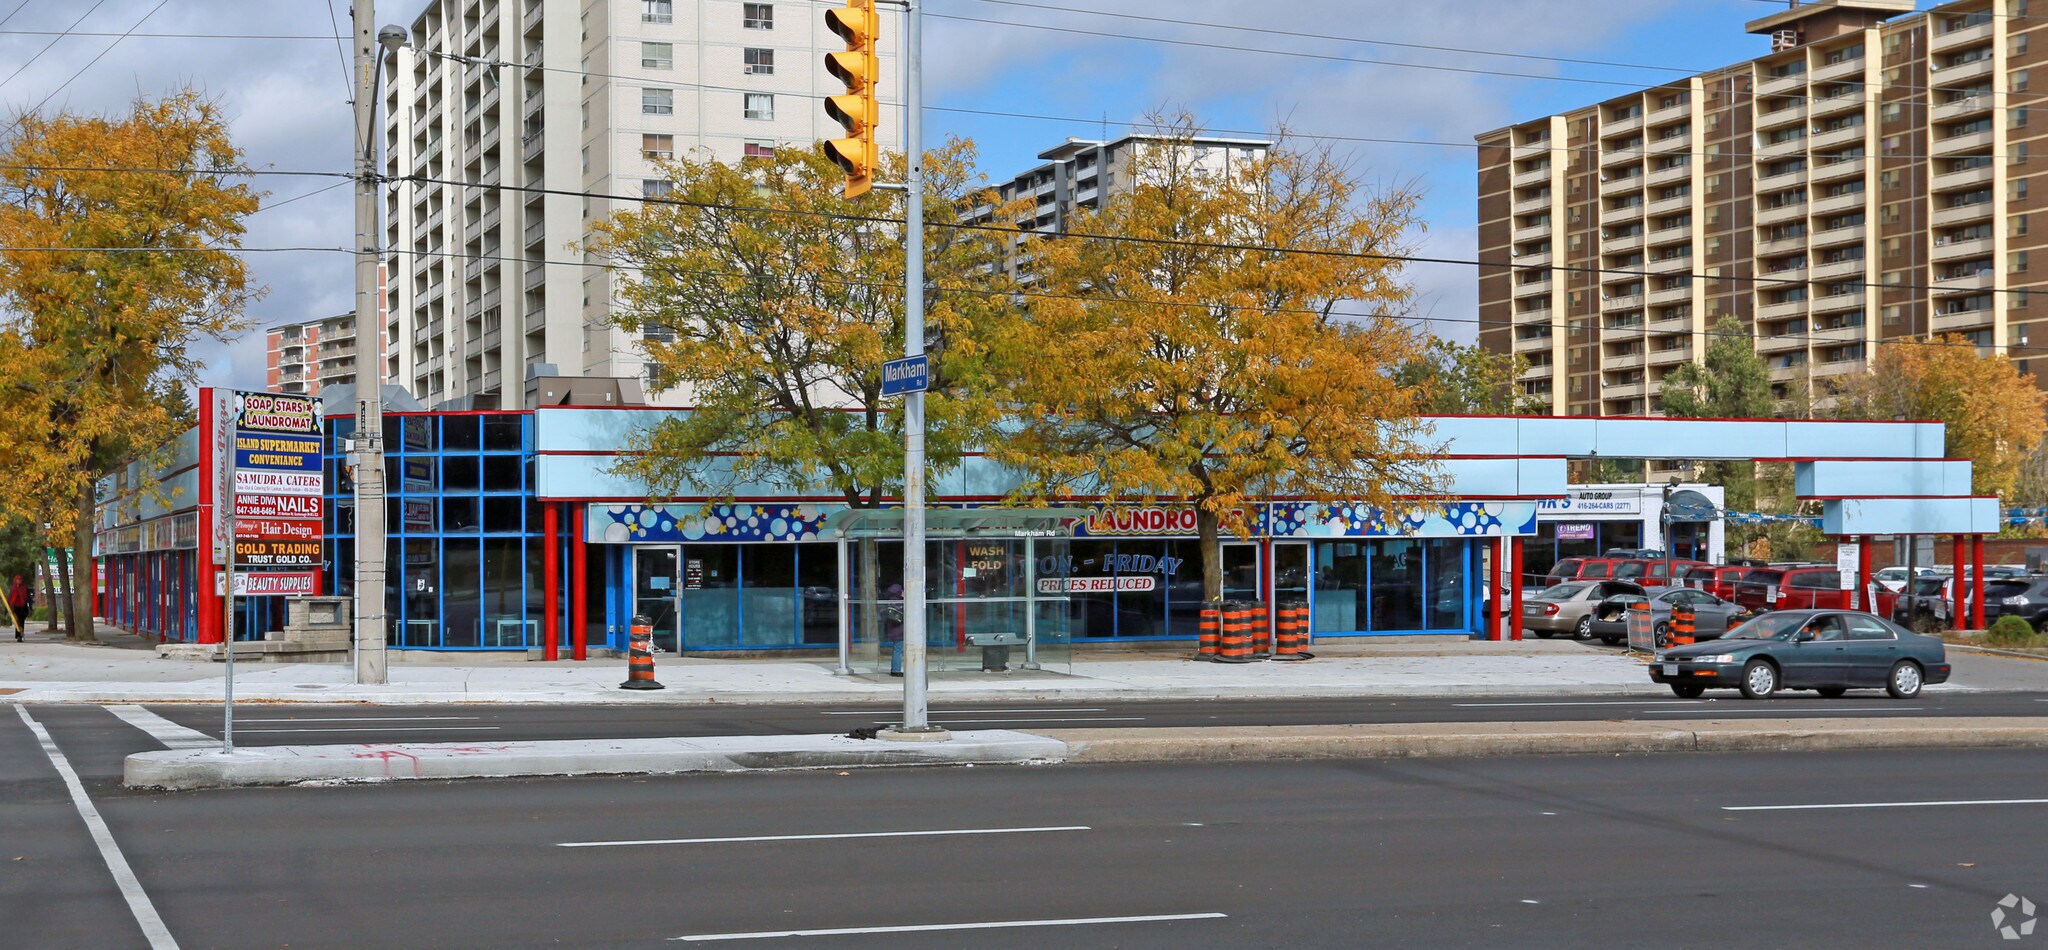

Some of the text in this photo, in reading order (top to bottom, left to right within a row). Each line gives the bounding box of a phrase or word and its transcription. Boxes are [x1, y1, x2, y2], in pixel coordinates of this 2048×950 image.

[885, 362, 925, 382] Markham
[246, 398, 302, 412] SOAP STARS
[218, 397, 229, 452] Plaza
[246, 415, 311, 428] LAUNDROMAT
[237, 438, 320, 453] ISLAND SUPERMARKET
[249, 454, 303, 466] CONVENIANCE
[236, 473, 320, 486] SAMUDRA CATERS
[237, 496, 276, 505] ANNIE DIVA
[277, 497, 318, 512] NAILS
[237, 506, 276, 515] 647-348-6464
[1090, 510, 1243, 530] LAUNDRO
[261, 522, 312, 538] Hair Design
[236, 544, 319, 554] GOLD TRADING
[970, 547, 1004, 556] WASH
[972, 561, 1002, 570] FOLD
[1102, 554, 1183, 575] FRIDAY
[248, 577, 278, 590] BEAUTY
[280, 577, 311, 590] SUPPLIES
[1041, 579, 1152, 591] PRICES REDUCED
